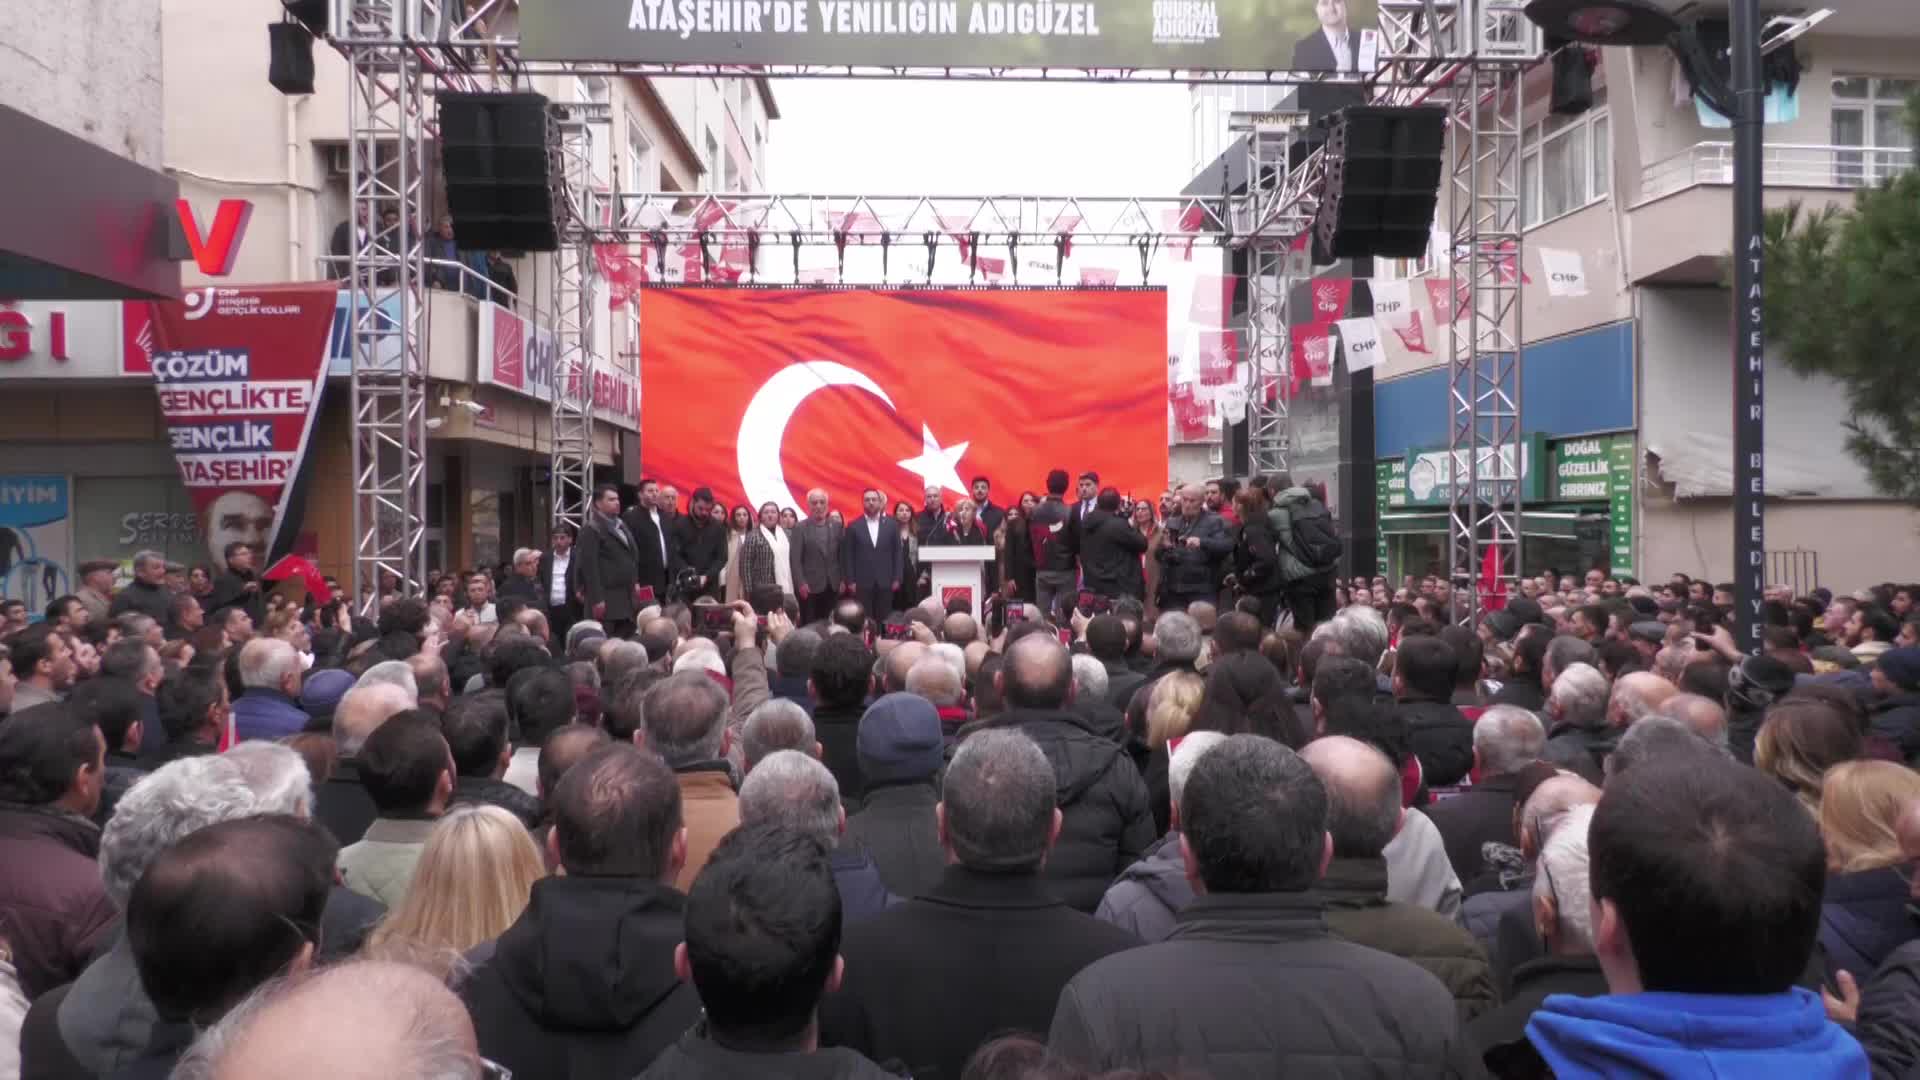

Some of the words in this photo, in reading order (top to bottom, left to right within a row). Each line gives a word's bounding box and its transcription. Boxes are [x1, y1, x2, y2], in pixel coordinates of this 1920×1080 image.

[1317, 302, 1339, 312] CHP
[1375, 301, 1401, 313] CHP
[1352, 340, 1377, 353] CHP
[151, 350, 248, 382] ÇÖZÜM
[1564, 440, 1602, 457] DOĞAL
